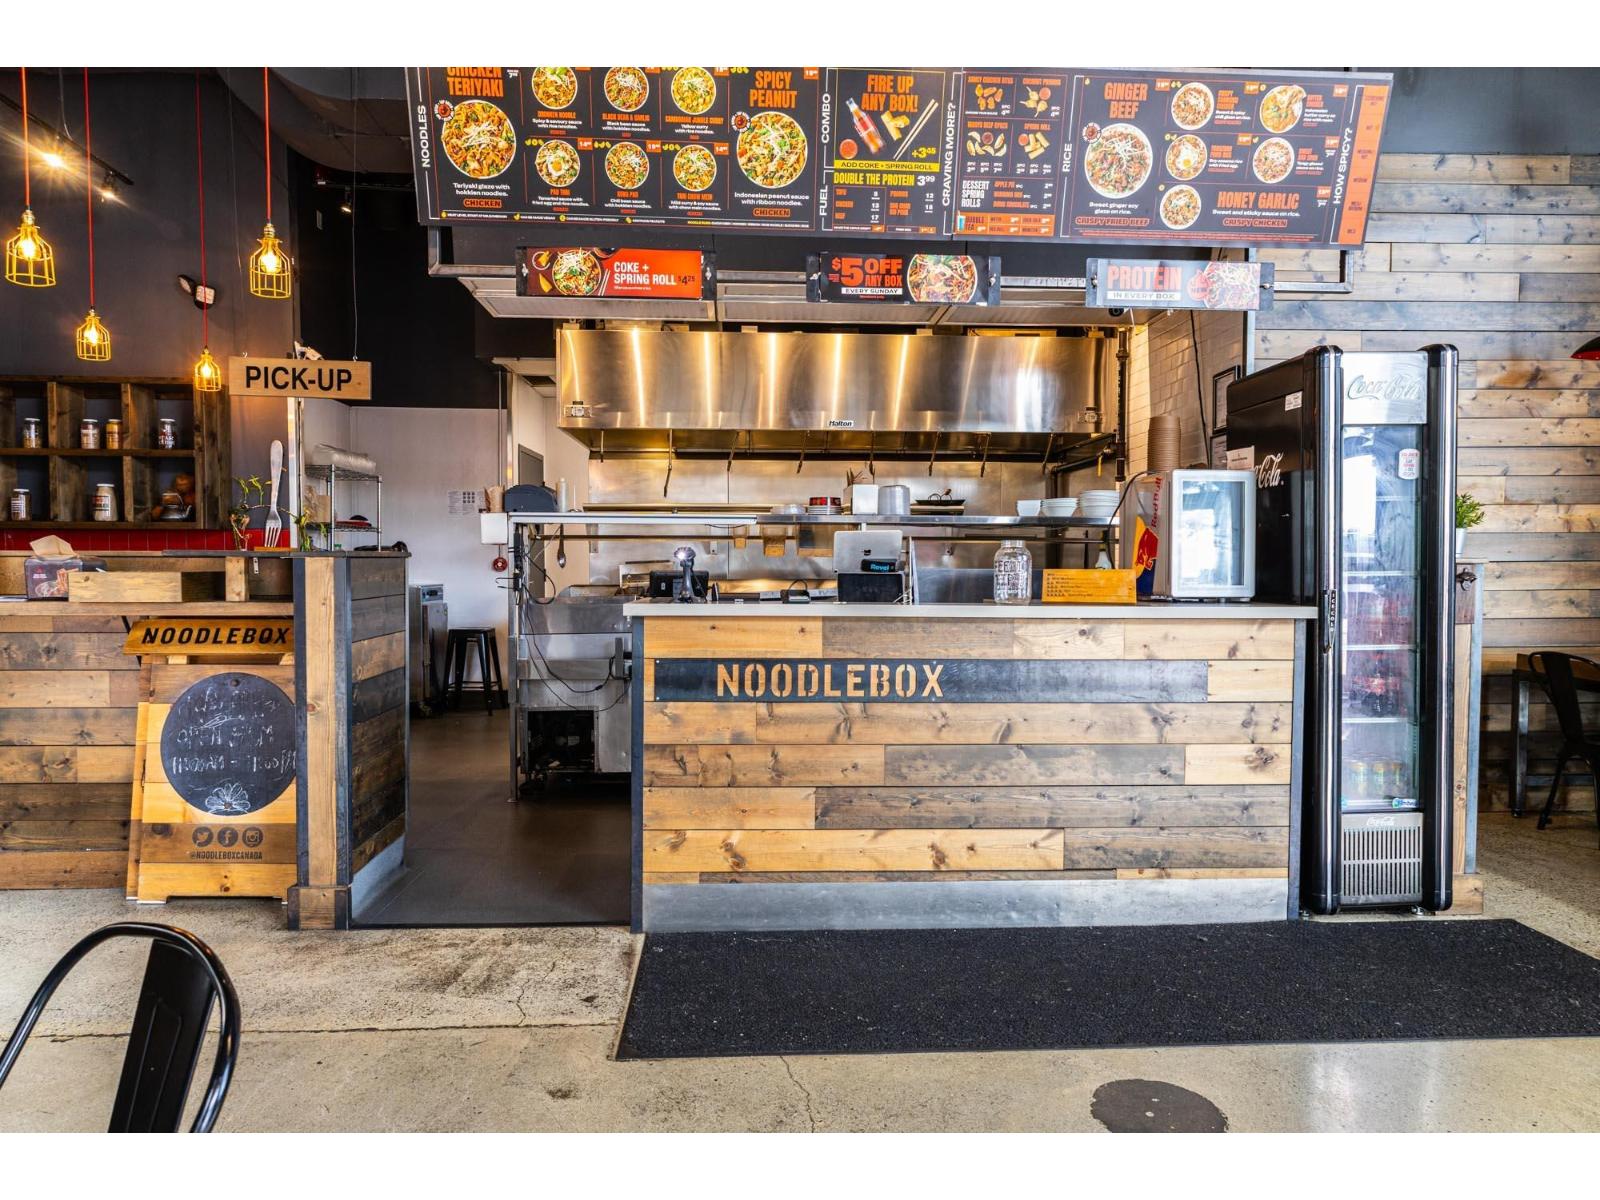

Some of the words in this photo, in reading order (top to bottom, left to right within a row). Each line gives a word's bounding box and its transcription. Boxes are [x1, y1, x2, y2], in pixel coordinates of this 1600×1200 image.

[447, 77, 504, 96] TERIYAKI
[756, 71, 792, 89] SPICY
[868, 74, 894, 92] FIRE
[897, 76, 914, 93] UP
[750, 89, 797, 108] PEANUT
[1104, 82, 1148, 101] GINGER
[861, 93, 886, 112] ANY
[889, 95, 918, 112] BOX!
[1109, 100, 1140, 119] BEEF
[821, 93, 831, 144] COMBO
[944, 102, 956, 150] MORE?
[418, 104, 431, 168] NOODLES
[1062, 143, 1072, 172] RICE
[1338, 127, 1353, 172] SPICY?
[834, 172, 864, 185] DOUBLE
[866, 173, 881, 185] THE
[882, 174, 915, 186] PROTEIN
[942, 150, 954, 206] CRAVING
[962, 180, 990, 190] DESSERT
[1333, 174, 1345, 204] HOW
[464, 200, 501, 208] CHICKEN
[819, 185, 828, 216] FUEL
[962, 198, 981, 208] ROLLS
[1217, 192, 1256, 209] HONEY
[1258, 193, 1300, 210] GARLIC
[614, 262, 639, 272] COKE
[832, 257, 864, 286] $5
[864, 258, 903, 274] OFF
[614, 273, 649, 284] SPRING
[653, 274, 677, 286] ROLL
[865, 275, 883, 287] ANY
[884, 275, 902, 287] BOX
[1108, 265, 1182, 290] PROTEIN
[246, 366, 352, 391] PICK-UP
[1348, 373, 1422, 400] Coca-Cola
[142, 627, 290, 645] NOODLEBOX
[716, 664, 944, 698] NOODLEBOX
[191, 850, 262, 860] @NOODLEBOXCANADA
